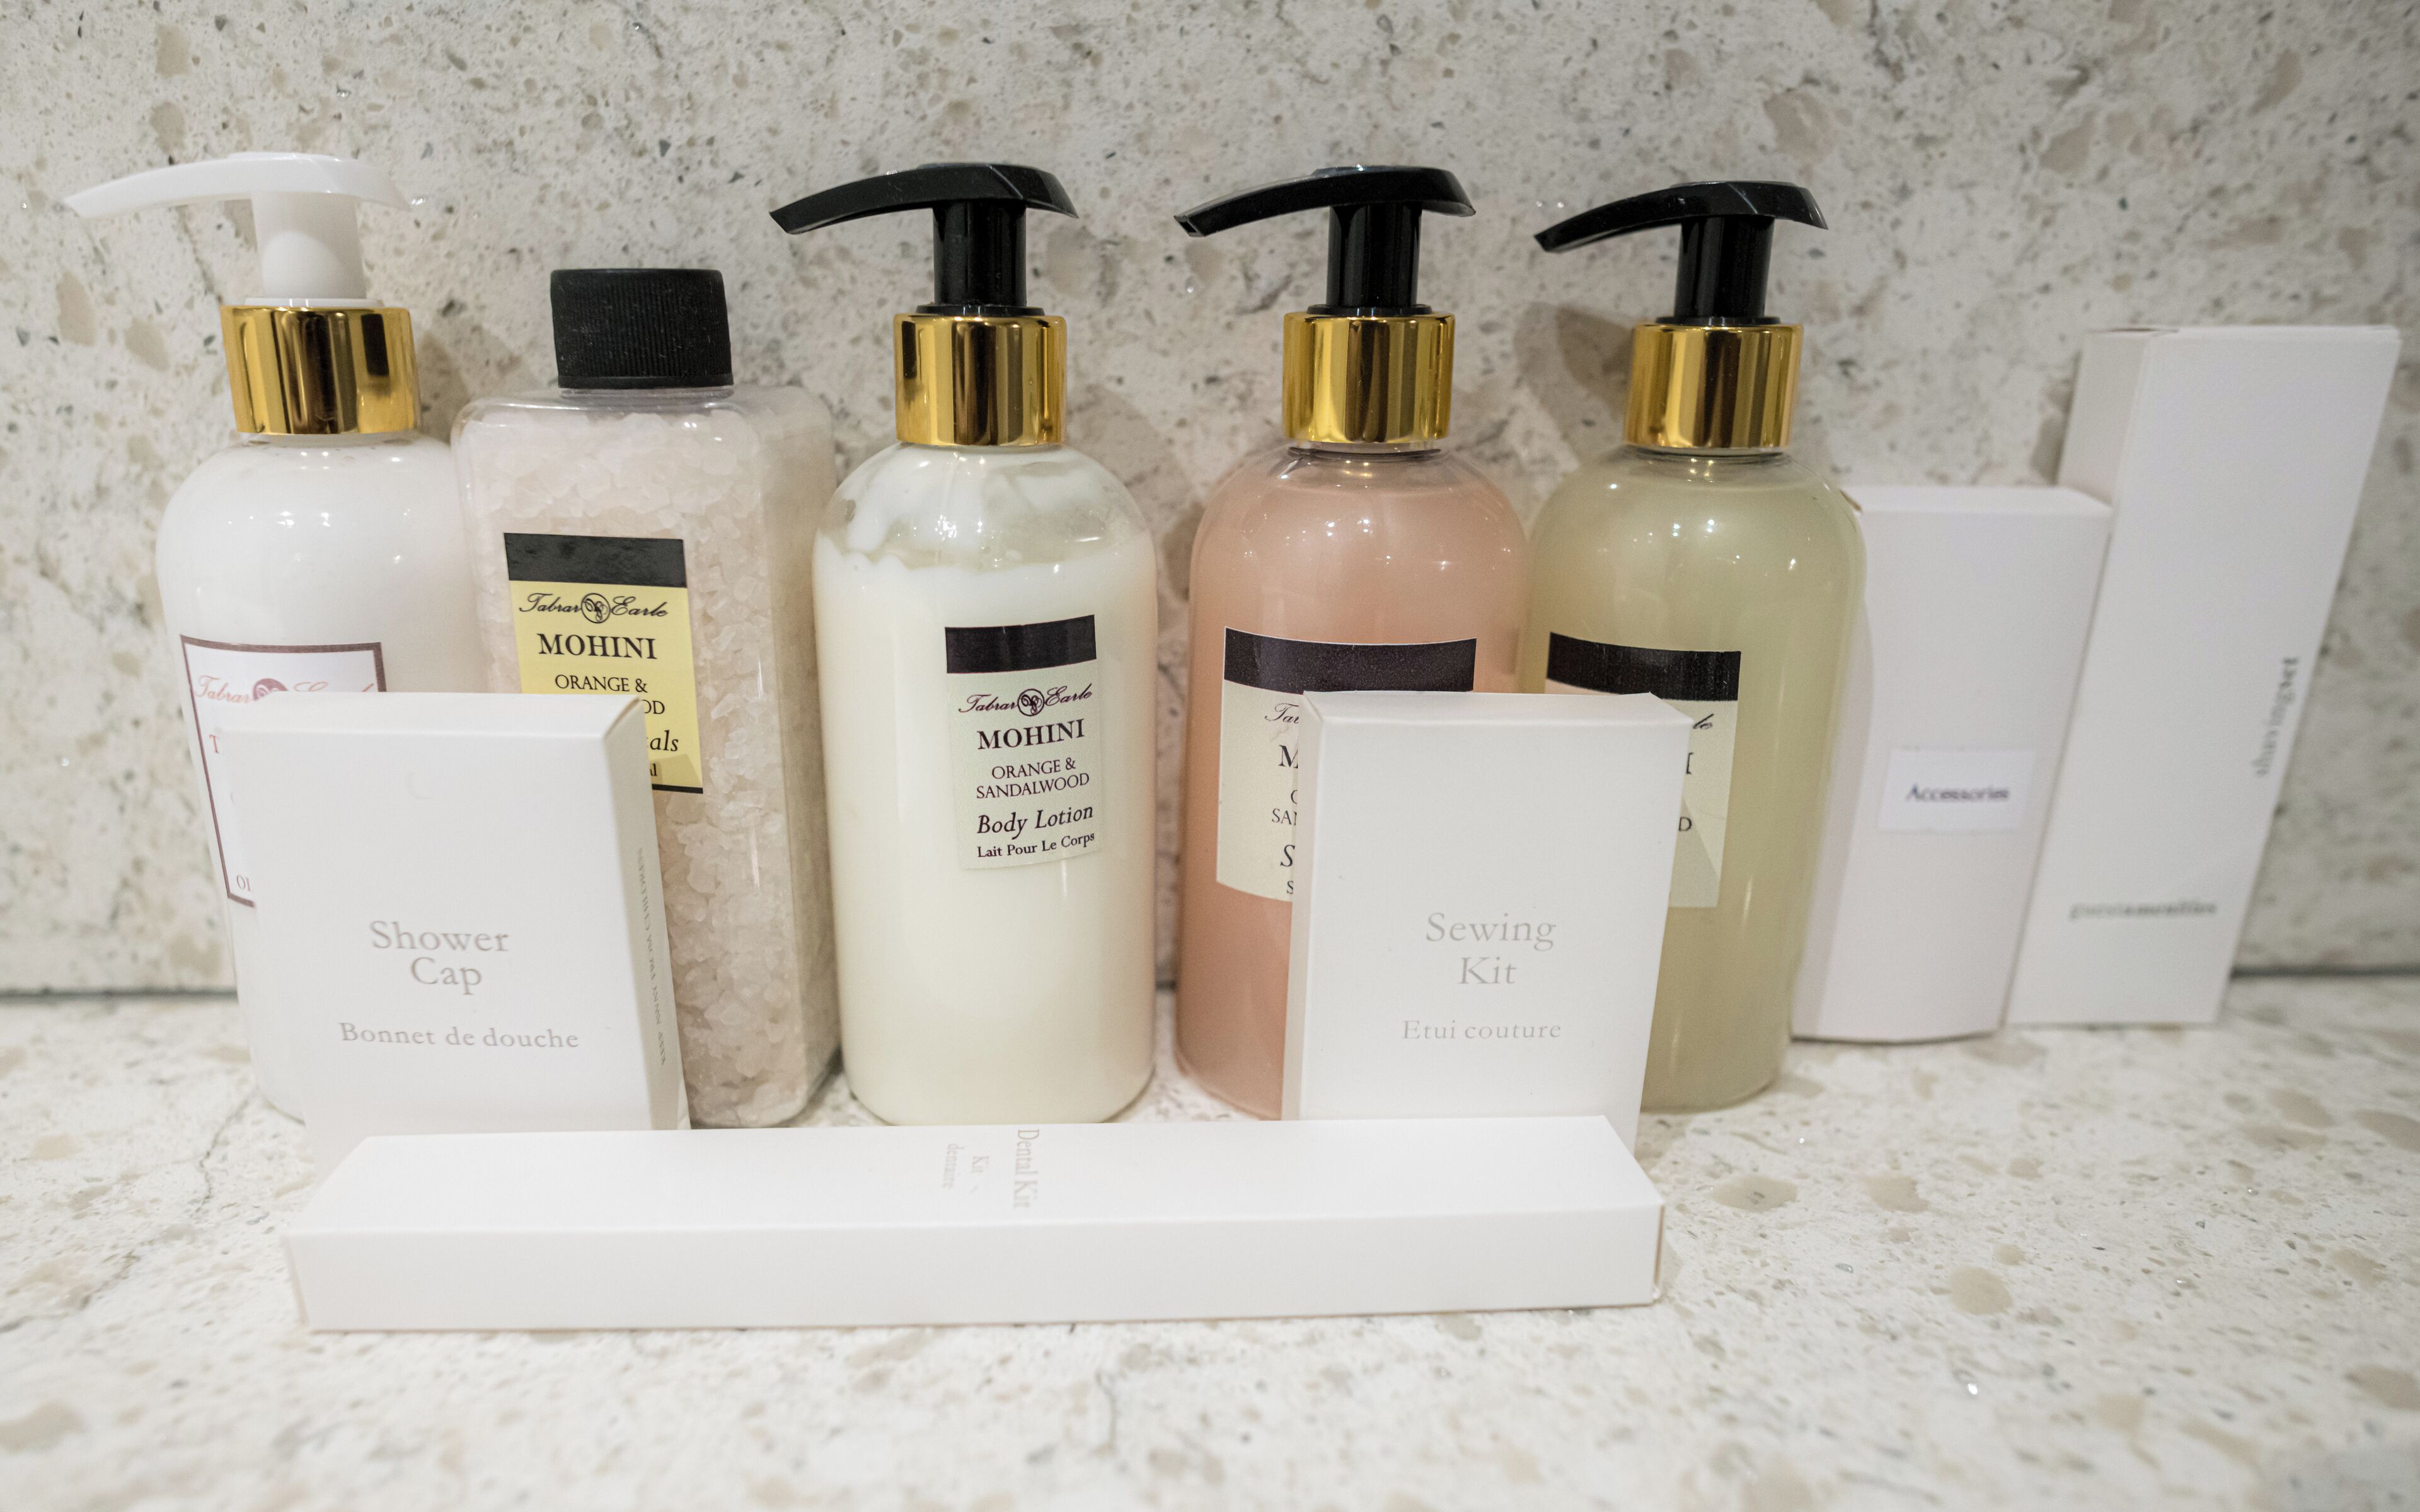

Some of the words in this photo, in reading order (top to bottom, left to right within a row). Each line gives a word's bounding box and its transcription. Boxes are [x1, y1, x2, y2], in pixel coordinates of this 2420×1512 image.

[519, 592, 582, 614] Tabrar
[611, 595, 669, 617] Earle
[536, 633, 658, 660] MOHINI
[195, 675, 251, 704] Tabrar
[554, 674, 630, 692] ORANGE
[635, 677, 648, 694] &
[958, 693, 1018, 713] Tabrar
[1044, 683, 1094, 707] Earle
[977, 718, 1085, 750] MOHINI
[991, 759, 1061, 780] ORANGE
[1065, 757, 1076, 770] &
[976, 772, 1090, 799] SANDALWOOD
[1905, 783, 2010, 803] Accessories
[977, 811, 1028, 840] Body
[1035, 806, 1094, 830] Lotion
[977, 845, 1003, 858] Lait
[1006, 842, 1038, 857] Pour
[1042, 840, 1057, 852] Le
[1061, 832, 1095, 849] Corps
[369, 920, 510, 953] Shower
[1425, 912, 1557, 952] Sewing
[410, 956, 483, 996] Cap
[1457, 956, 1518, 985] Kit
[338, 1022, 435, 1046] Bonnet
[444, 1026, 476, 1046] de
[482, 1027, 580, 1049] douche
[1402, 1019, 1456, 1040] Etui
[1464, 1024, 1562, 1040] couture
[971, 1155, 990, 1174] Kit
[1015, 1128, 1040, 1176] Dental
[1011, 1179, 1039, 1208] Kit
